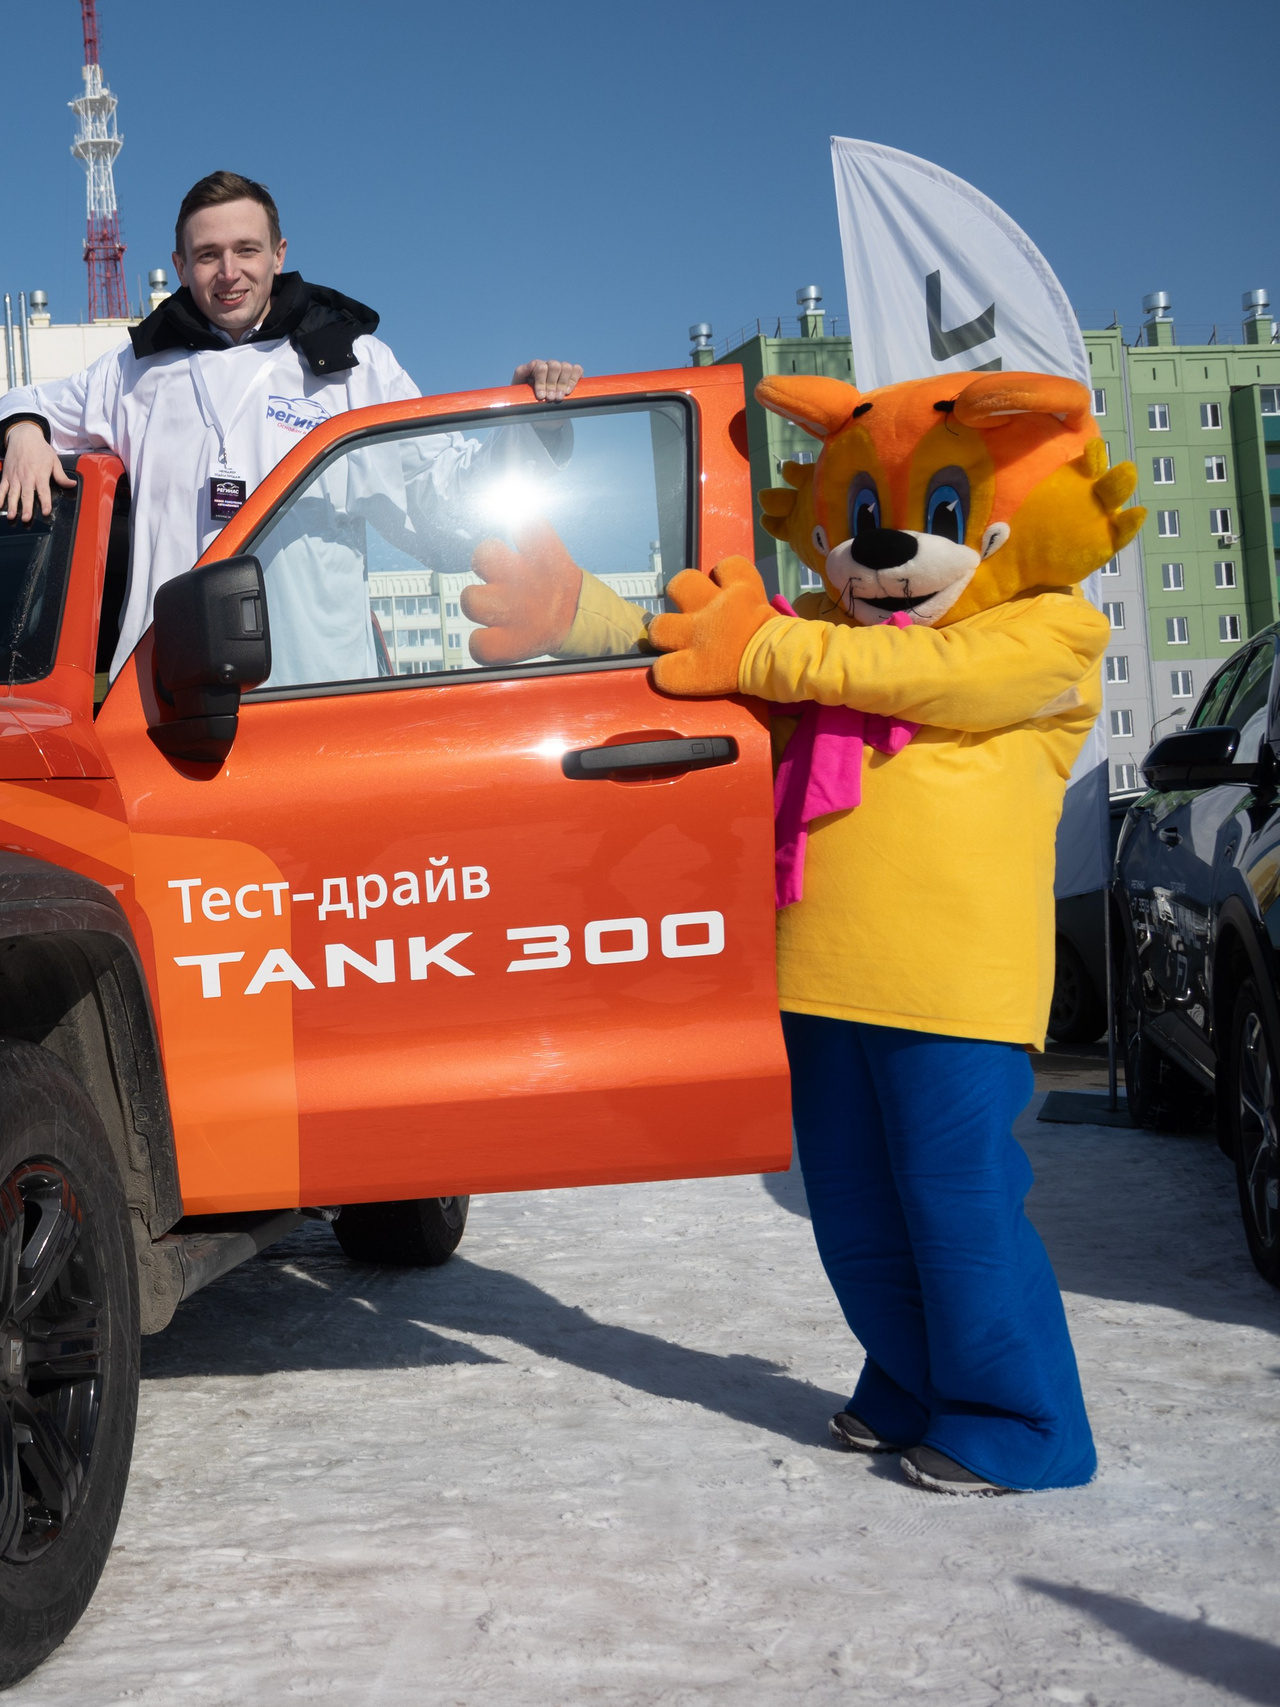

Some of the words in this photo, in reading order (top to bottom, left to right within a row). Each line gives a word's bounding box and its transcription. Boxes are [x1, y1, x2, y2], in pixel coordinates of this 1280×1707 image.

[266, 405, 320, 430] регин
[167, 855, 491, 924] Тест-драйв
[172, 931, 476, 999] TANK
[505, 910, 726, 973] 300
